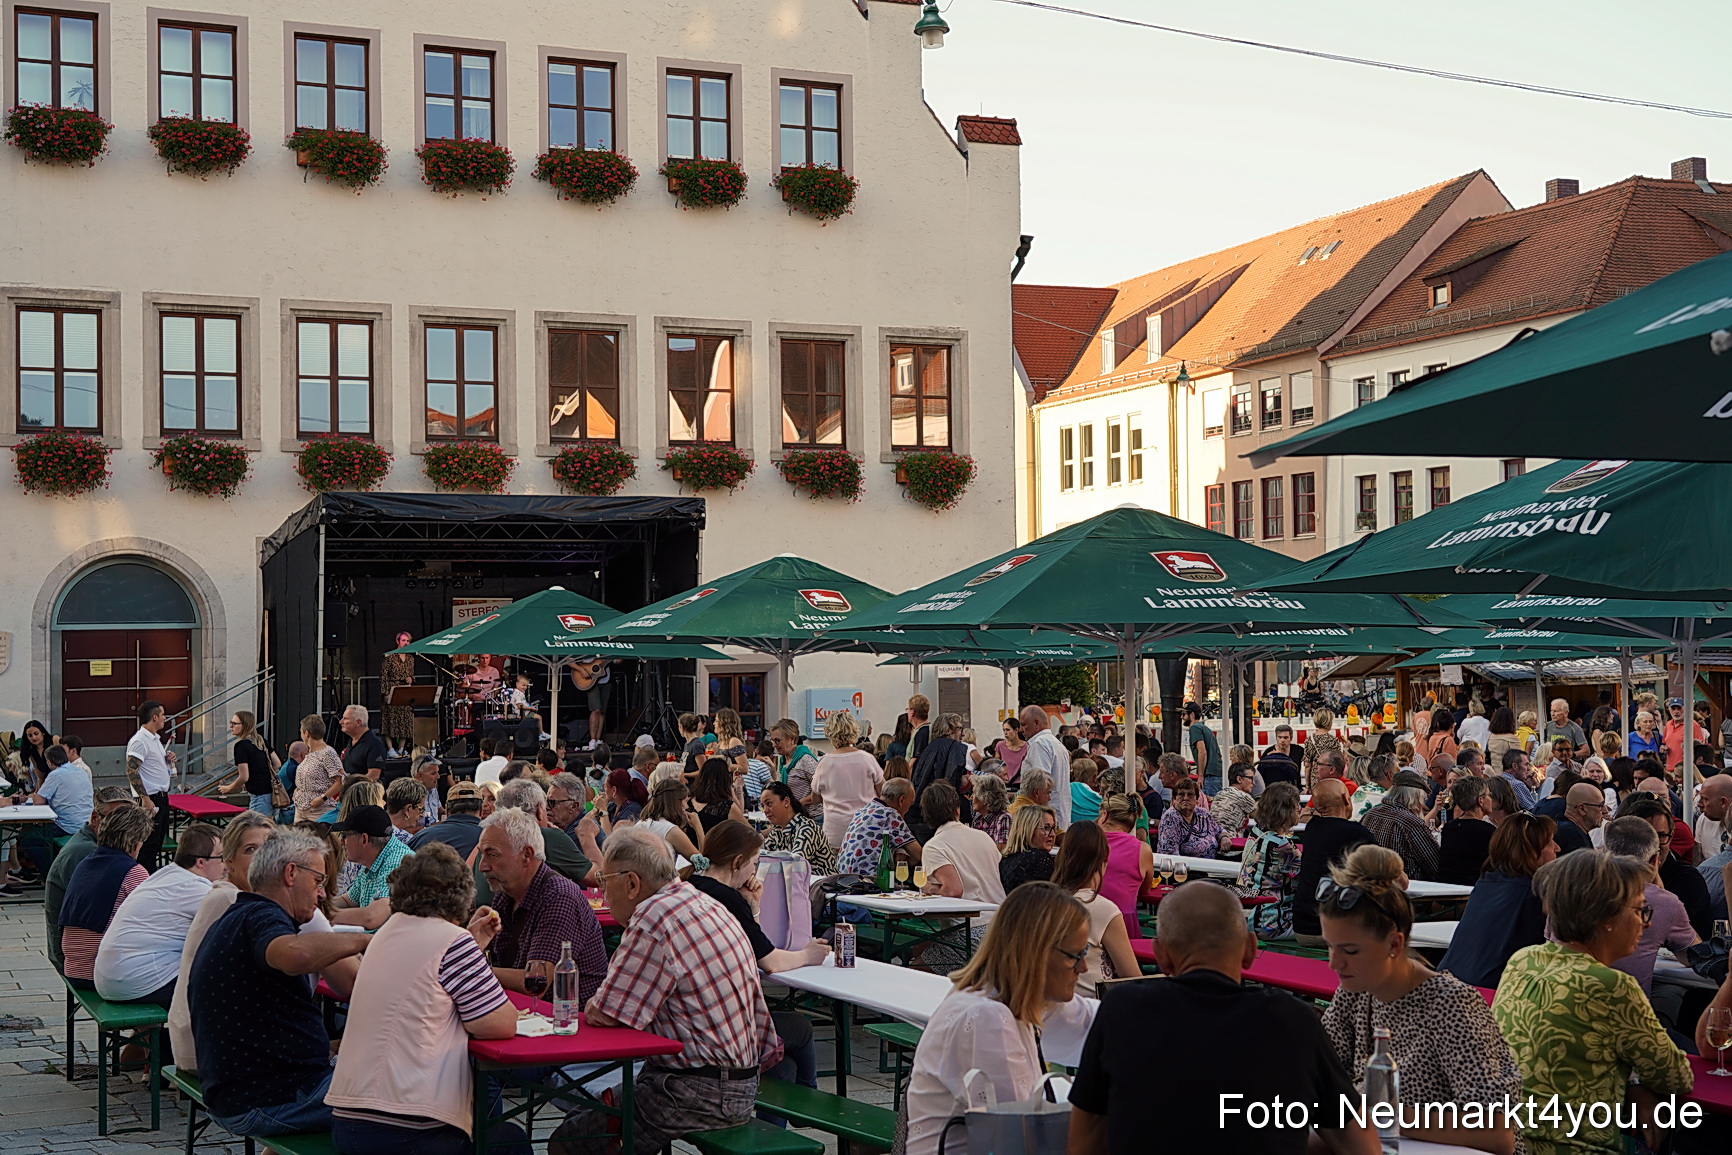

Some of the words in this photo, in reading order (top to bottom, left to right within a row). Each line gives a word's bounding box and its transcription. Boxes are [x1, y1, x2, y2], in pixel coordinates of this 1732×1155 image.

[1474, 493, 1609, 525] Neumarkter
[1155, 586, 1271, 597] Neumarter
[1143, 596, 1307, 610] Lammsbräu
[814, 707, 851, 719] Kut
